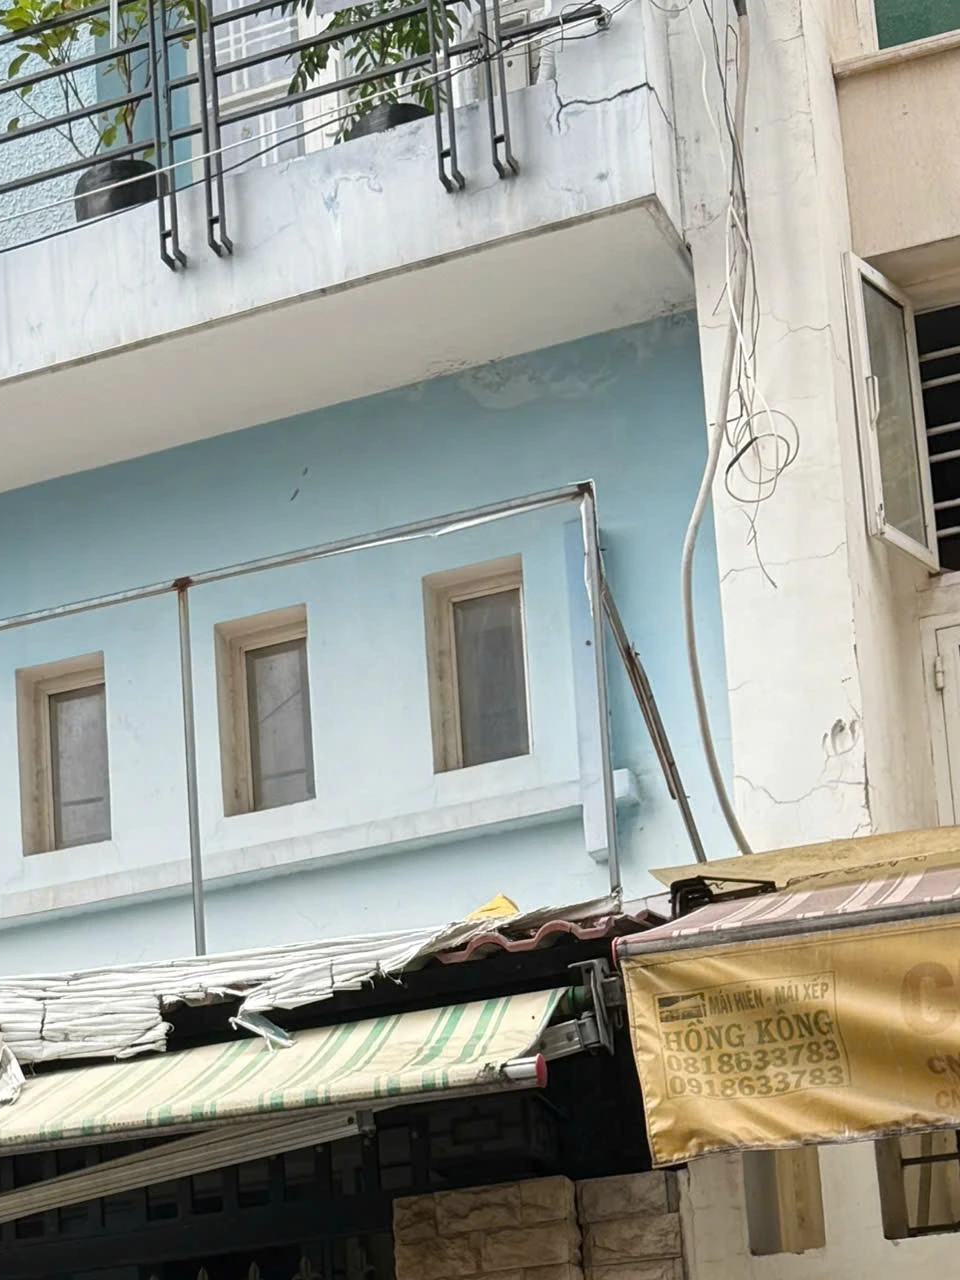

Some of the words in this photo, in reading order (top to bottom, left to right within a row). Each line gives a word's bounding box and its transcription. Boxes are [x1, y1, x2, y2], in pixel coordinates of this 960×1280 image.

[663, 1018, 746, 1053] HỒNG
[757, 1009, 834, 1044] KÔNG
[666, 1039, 841, 1075] 0818633783
[669, 1066, 845, 1098] 0918633783
